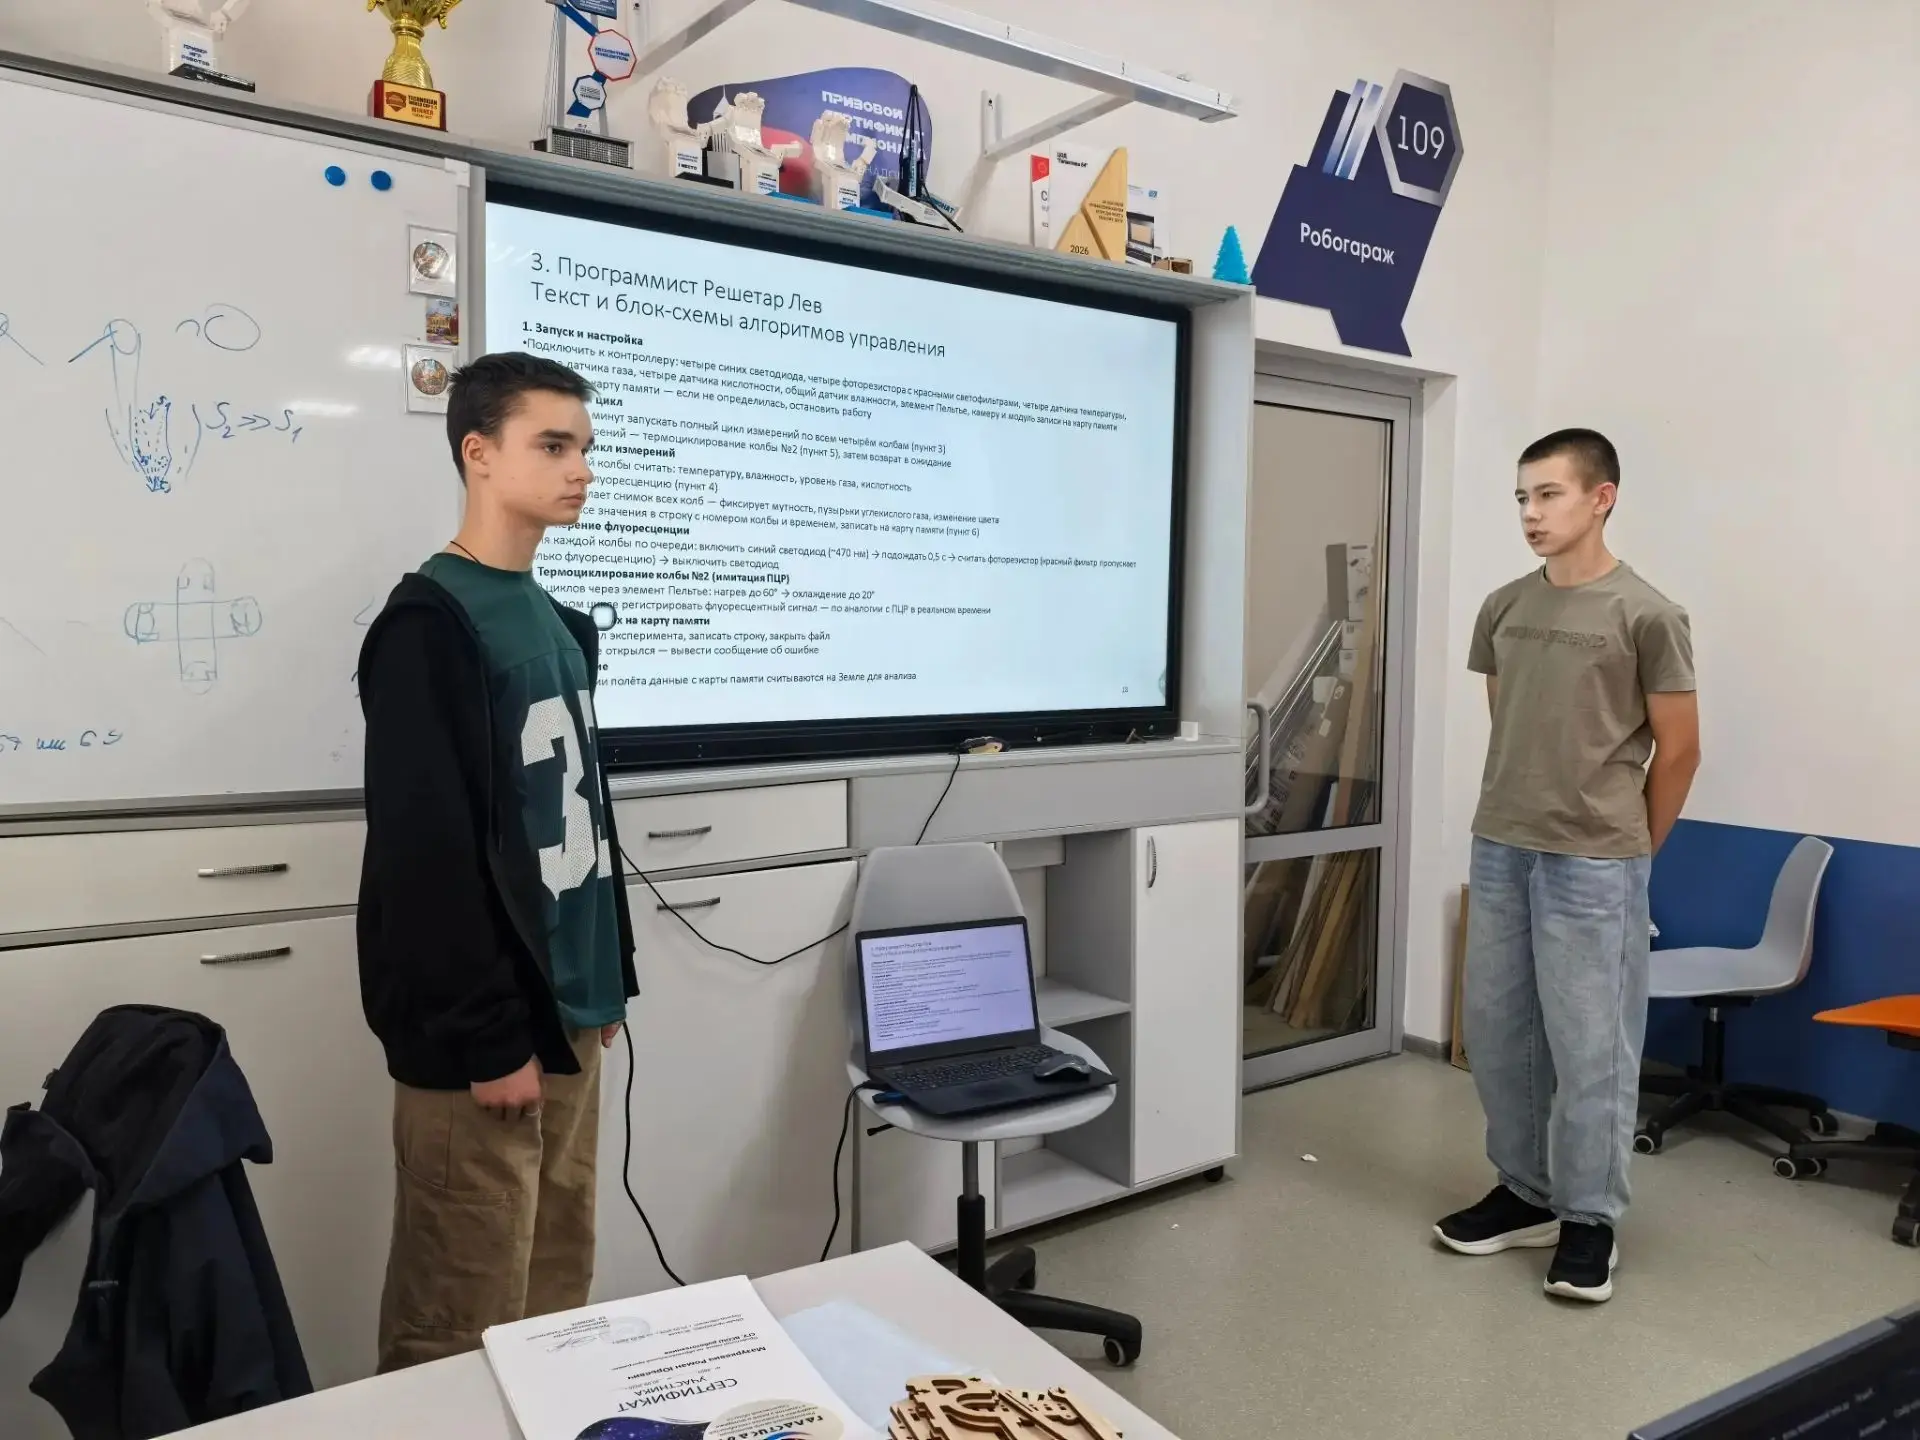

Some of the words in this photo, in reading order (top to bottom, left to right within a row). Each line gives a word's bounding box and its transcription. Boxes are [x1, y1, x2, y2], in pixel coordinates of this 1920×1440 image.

[1397, 115, 1445, 159] 109
[1070, 245, 1089, 255] 2026
[1300, 222, 1395, 265] Робогараж
[531, 252, 549, 272] 3.
[558, 256, 698, 294] Программист
[704, 279, 784, 311] Решетар
[788, 293, 822, 313] Лев
[530, 281, 590, 307] Текст
[597, 295, 608, 309] и
[615, 293, 732, 327] блок-схемы
[739, 316, 844, 343] алгоритмов
[849, 332, 944, 357] управления
[522, 321, 532, 331] 1.
[535, 322, 574, 338] Запуск
[577, 330, 583, 338] и
[587, 332, 643, 345] настройка
[607, 350, 678, 368] контроллеру:
[680, 359, 716, 372] четыре
[718, 364, 747, 374] синих
[749, 367, 806, 382] светодиода,
[807, 375, 840, 386] четыре
[567, 361, 609, 373] датчика
[612, 366, 637, 378] газа,
[639, 369, 676, 382] четыре
[678, 374, 719, 386] датчика
[721, 379, 782, 395] кислотности,
[784, 385, 816, 397] общий
[817, 391, 848, 400] датчик
[595, 396, 623, 406] цикл
[622, 383, 660, 395] памяти
[676, 389, 699, 399] если
[716, 394, 787, 410] определилась,
[789, 402, 839, 414] остановить
[592, 412, 624, 424] минут
[627, 415, 677, 427] запускать
[679, 420, 718, 430] полный
[721, 424, 744, 433] цикл
[746, 427, 799, 439] измерений
[589, 442, 613, 453] икл
[615, 445, 675, 458] измерений
[642, 432, 746, 449] термоциклирование
[749, 441, 777, 452] колбы
[780, 443, 797, 454] №2
[593, 475, 672, 488] луоресценцию
[597, 458, 630, 470] колбы
[633, 463, 675, 473] считать:
[677, 466, 744, 480] температуру,
[745, 471, 797, 484] влажность,
[799, 476, 836, 486] уровень
[613, 492, 653, 502] снимок
[655, 495, 678, 504] всех
[680, 495, 703, 505] колб
[719, 497, 769, 511] фиксирует
[771, 503, 816, 514] мутность,
[598, 507, 647, 517] значения
[658, 511, 692, 522] строку
[702, 514, 748, 524] номером
[750, 515, 778, 525] колбы
[789, 518, 838, 529] временем,
[604, 520, 689, 536] флуоресценции
[553, 535, 595, 547] каждой
[598, 537, 631, 548] колбы
[634, 540, 648, 548] по
[650, 541, 697, 551] очереди:
[699, 543, 745, 552] включить
[747, 544, 776, 553] синий
[778, 547, 826, 557] светодиод
[535, 552, 562, 561] лько
[564, 551, 656, 566] флуоресценцию)
[672, 557, 727, 567] выключить
[729, 560, 779, 570] светодиод
[537, 566, 654, 580] Термоциклирование
[656, 570, 689, 580] колбы
[691, 571, 709, 581] №2
[546, 584, 585, 596] циклов
[588, 585, 620, 595] через
[622, 586, 665, 594] элемент
[668, 585, 711, 596] Пельтье:
[713, 589, 747, 598] нагрев
[792, 590, 846, 600] охлаждение
[621, 601, 703, 611] регистрировать
[704, 600, 785, 612] флуоресцентный
[787, 604, 817, 612] сигнал
[640, 617, 670, 627] карту
[610, 632, 686, 642] эксперимента,
[733, 633, 767, 642] строку,
[769, 633, 806, 642] закрыть
[807, 630, 830, 642] файл
[605, 647, 655, 656] открылся
[670, 647, 711, 655] вывести
[713, 644, 768, 655] сообщение
[784, 644, 819, 654] ошибке
[610, 676, 646, 686] полёта
[648, 677, 688, 686] данные
[698, 676, 727, 685] карты
[766, 674, 823, 683] считываются
[617, 1378, 738, 1413] СЕРТИФИКАТ
[634, 1376, 708, 1397] УЧАСТНИКА
